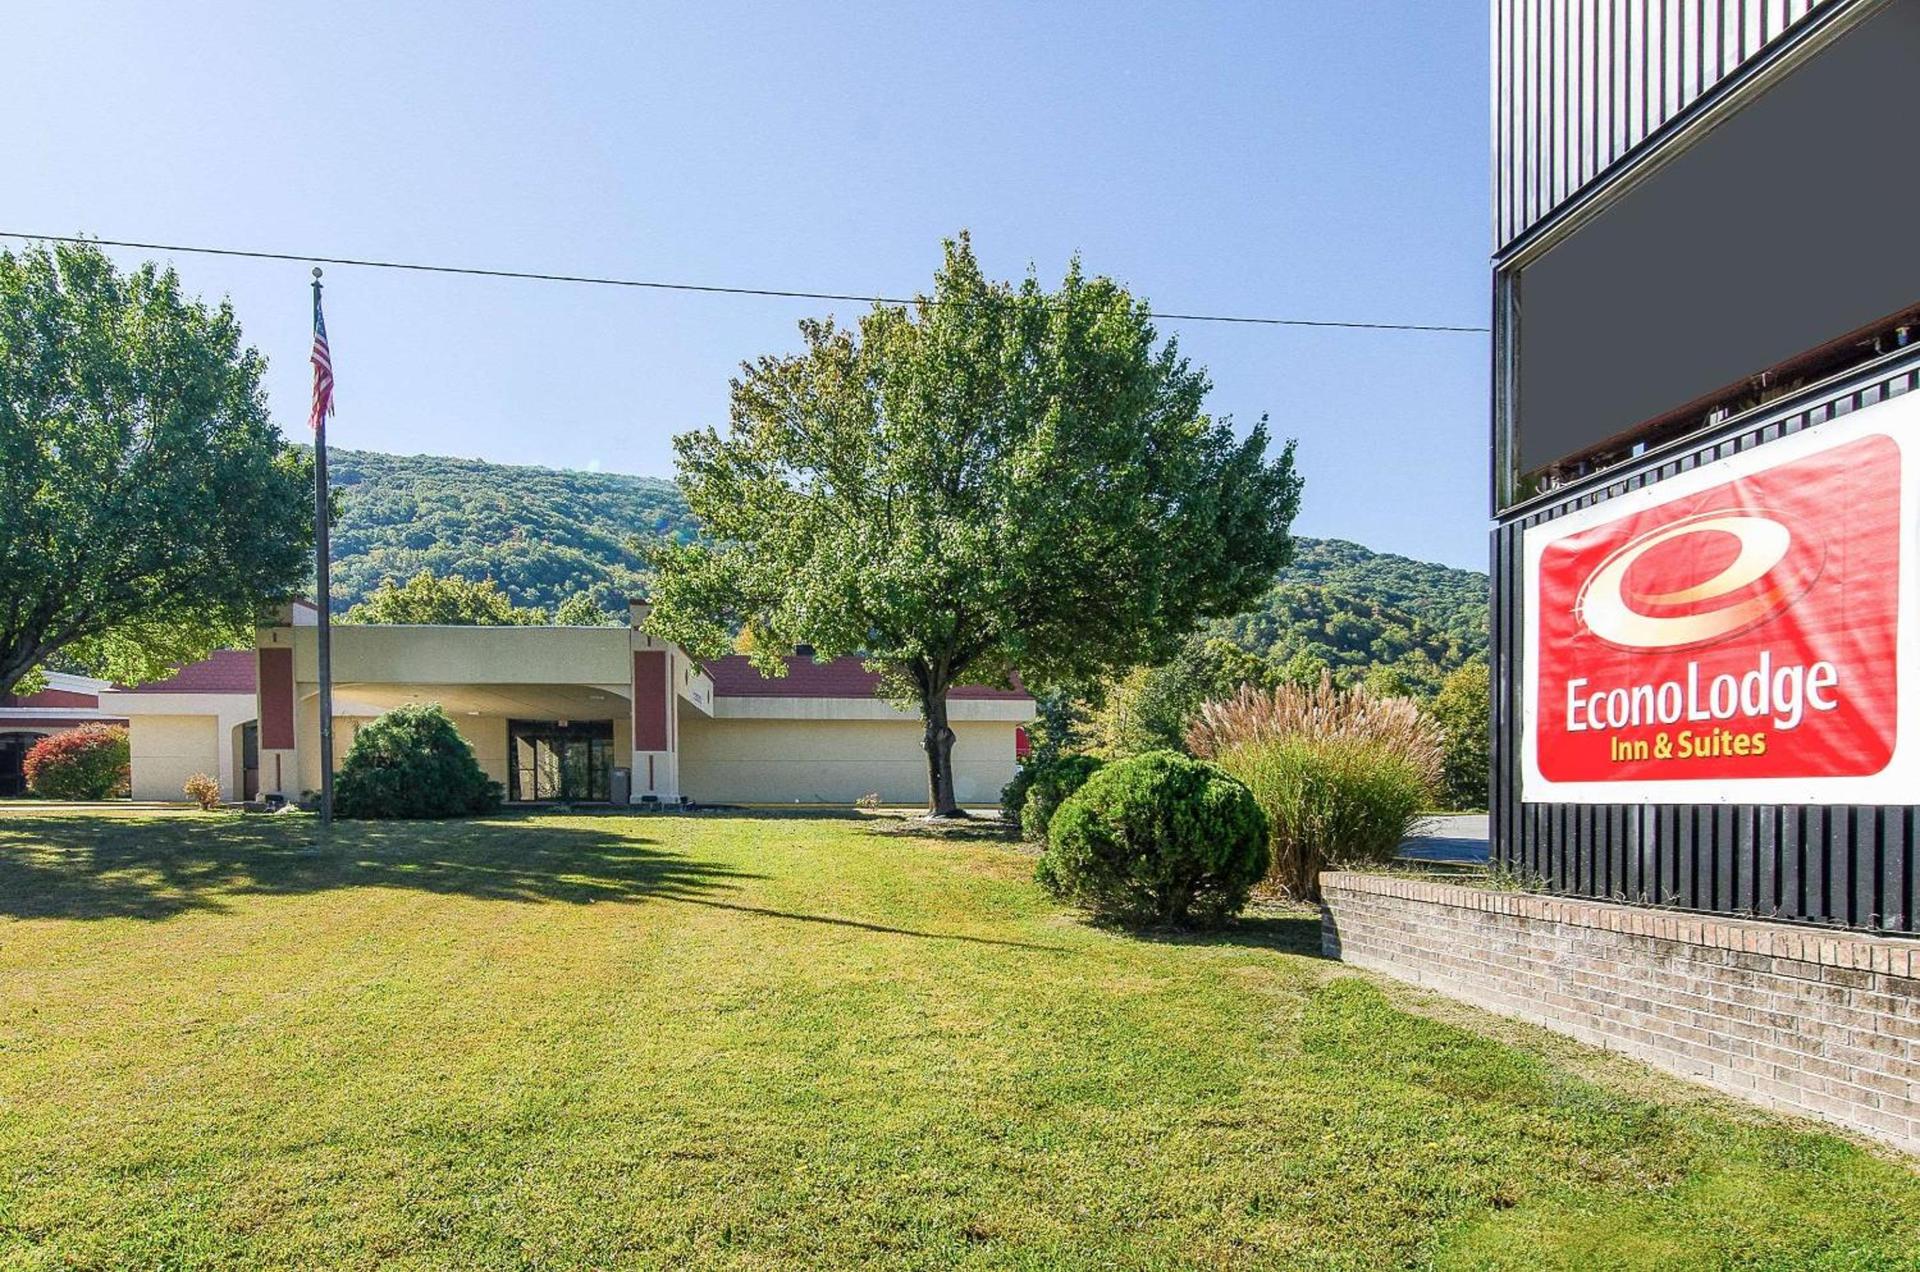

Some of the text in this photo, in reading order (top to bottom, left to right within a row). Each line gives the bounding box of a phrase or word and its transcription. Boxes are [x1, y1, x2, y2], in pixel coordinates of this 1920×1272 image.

[1611, 727, 1767, 761] Inn & Suites
